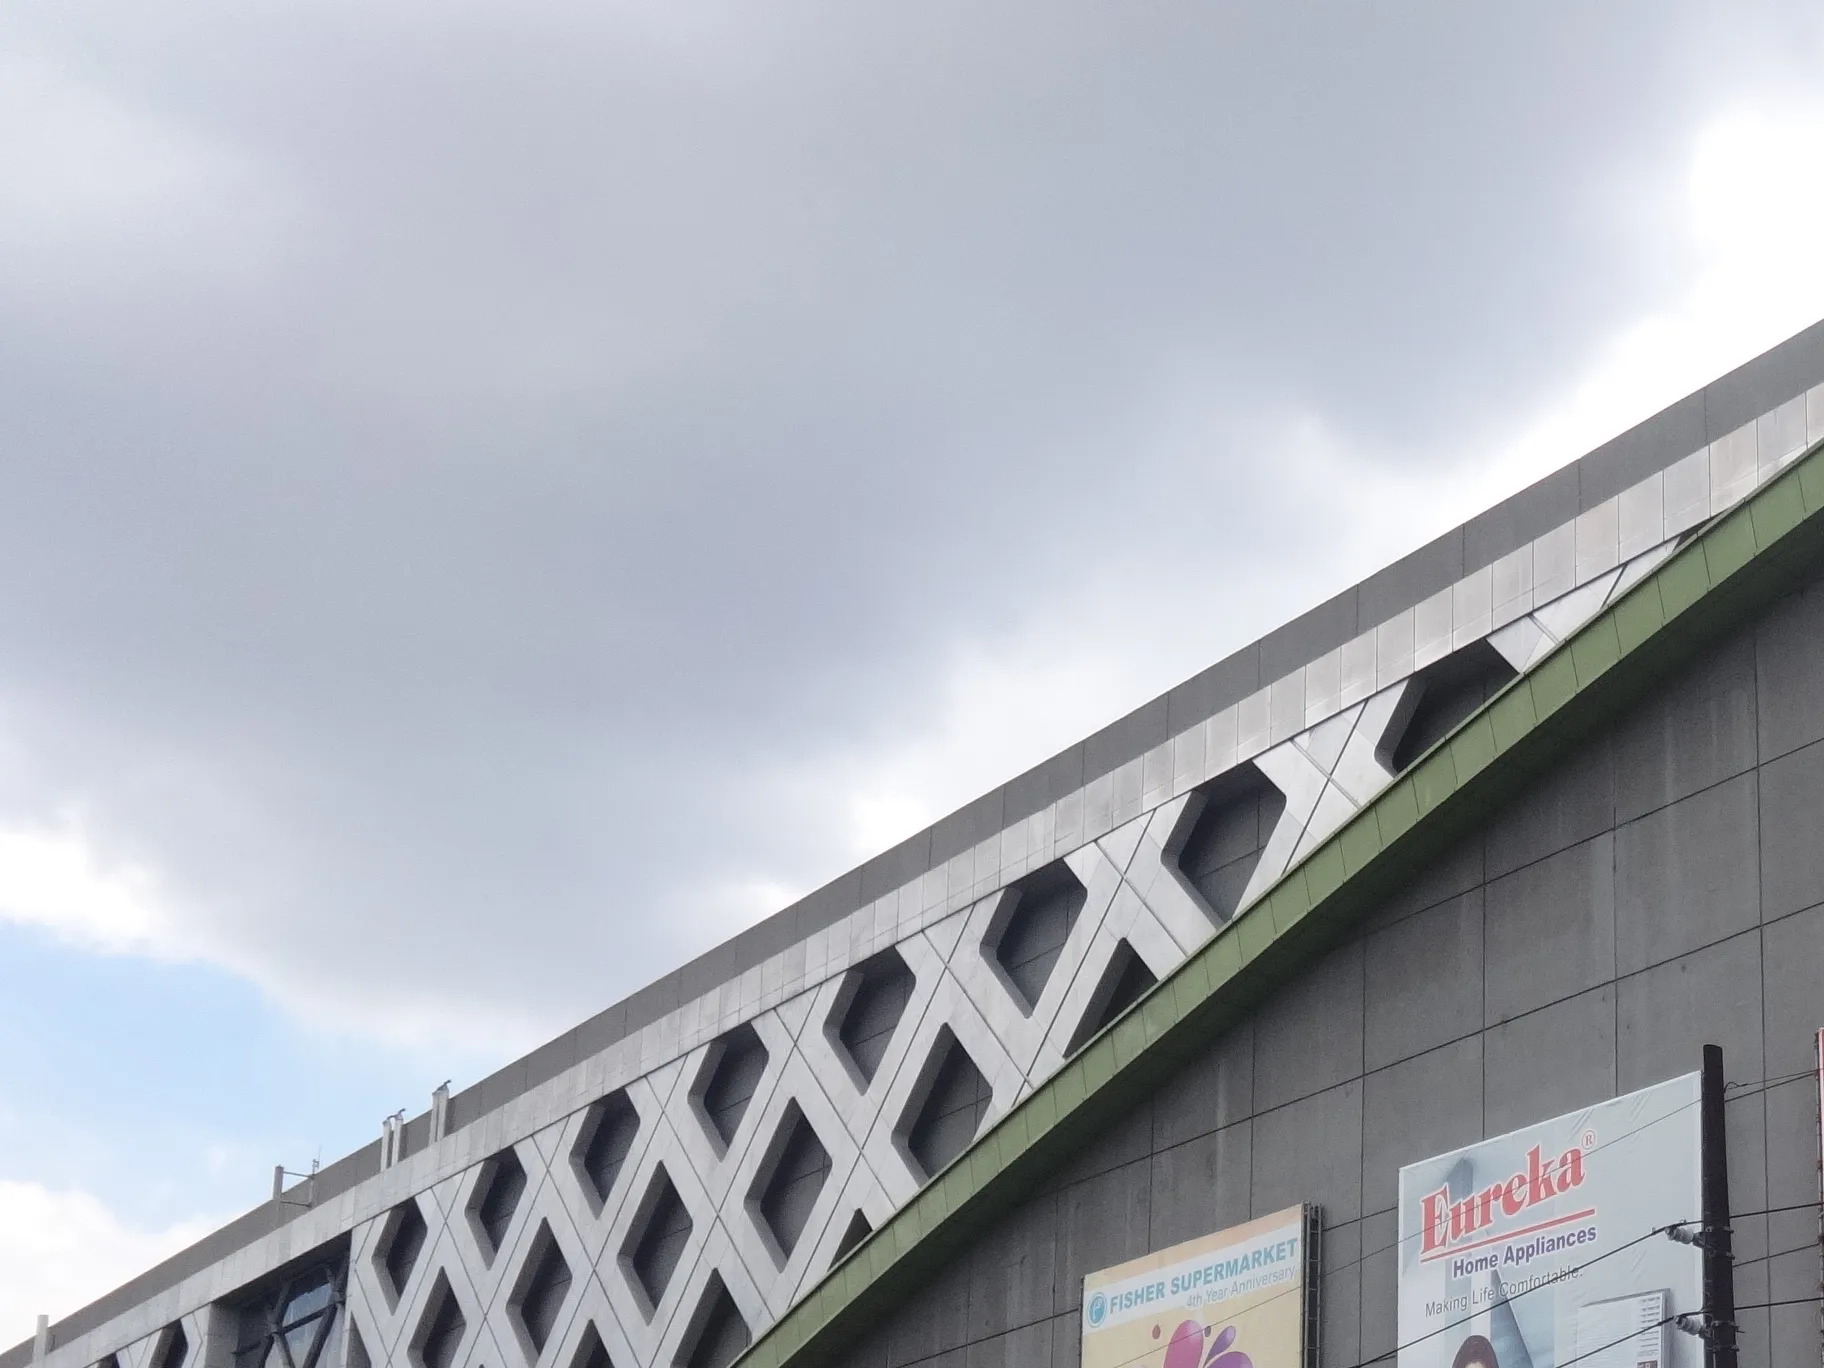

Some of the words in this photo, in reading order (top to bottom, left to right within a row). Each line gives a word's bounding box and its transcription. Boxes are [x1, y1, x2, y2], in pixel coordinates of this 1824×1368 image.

[1420, 1145, 1586, 1255] Eureka
[1109, 1282, 1165, 1313] FISHER
[1171, 1238, 1298, 1295] SUPERMARKET
[1453, 1254, 1498, 1278] Home
[1503, 1226, 1597, 1266] Appliances
[1186, 1295, 1203, 1308] 4th
[1206, 1287, 1229, 1302] Year
[1230, 1266, 1296, 1297] Anniversary
[1424, 1294, 1467, 1318] Making
[1472, 1288, 1494, 1306] Life
[1500, 1265, 1583, 1298] Comfortable.
